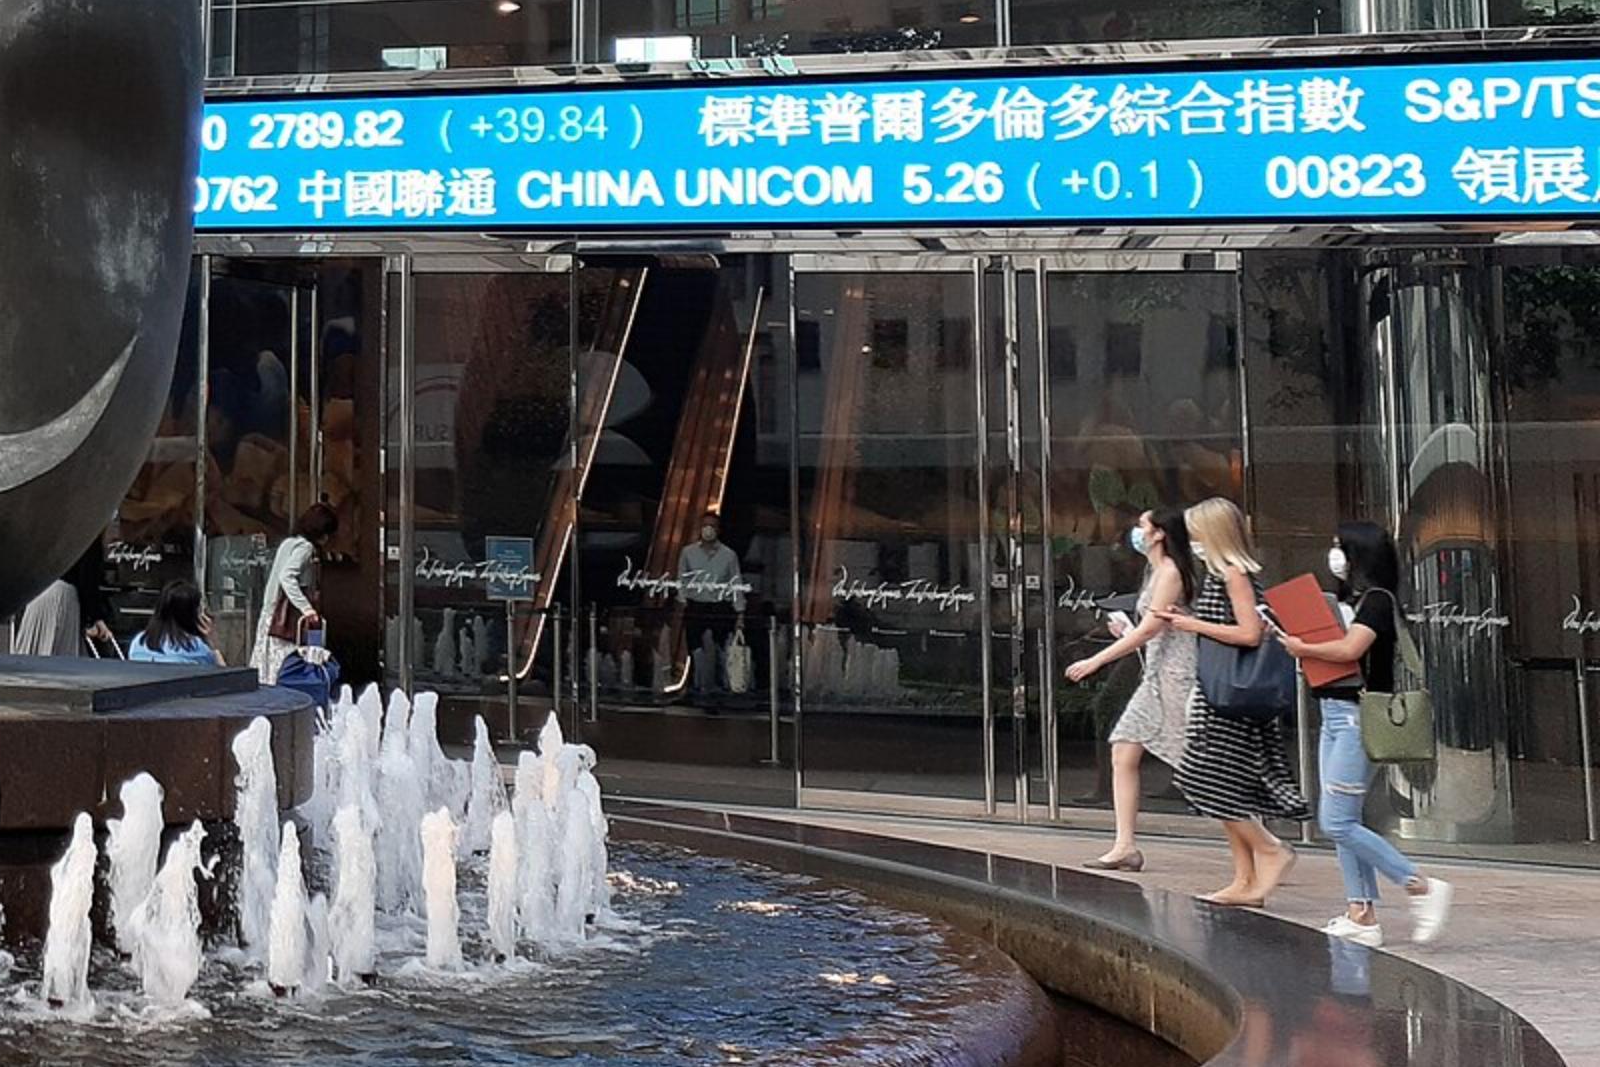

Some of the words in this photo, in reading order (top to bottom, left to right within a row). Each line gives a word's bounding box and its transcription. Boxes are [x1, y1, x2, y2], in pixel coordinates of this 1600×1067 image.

[248, 110, 405, 150] 2789.82
[468, 104, 609, 144] +39.84
[698, 76, 1367, 148] 標準普爾多倫多綜合指數
[298, 168, 498, 219] 中國聯通
[517, 170, 664, 207] CHINA
[674, 164, 873, 206] UNICOM
[903, 161, 1004, 204] 5.26
[1061, 159, 1160, 200] +0.1
[1265, 153, 1427, 200] 00823
[1451, 145, 1600, 205] 領展
